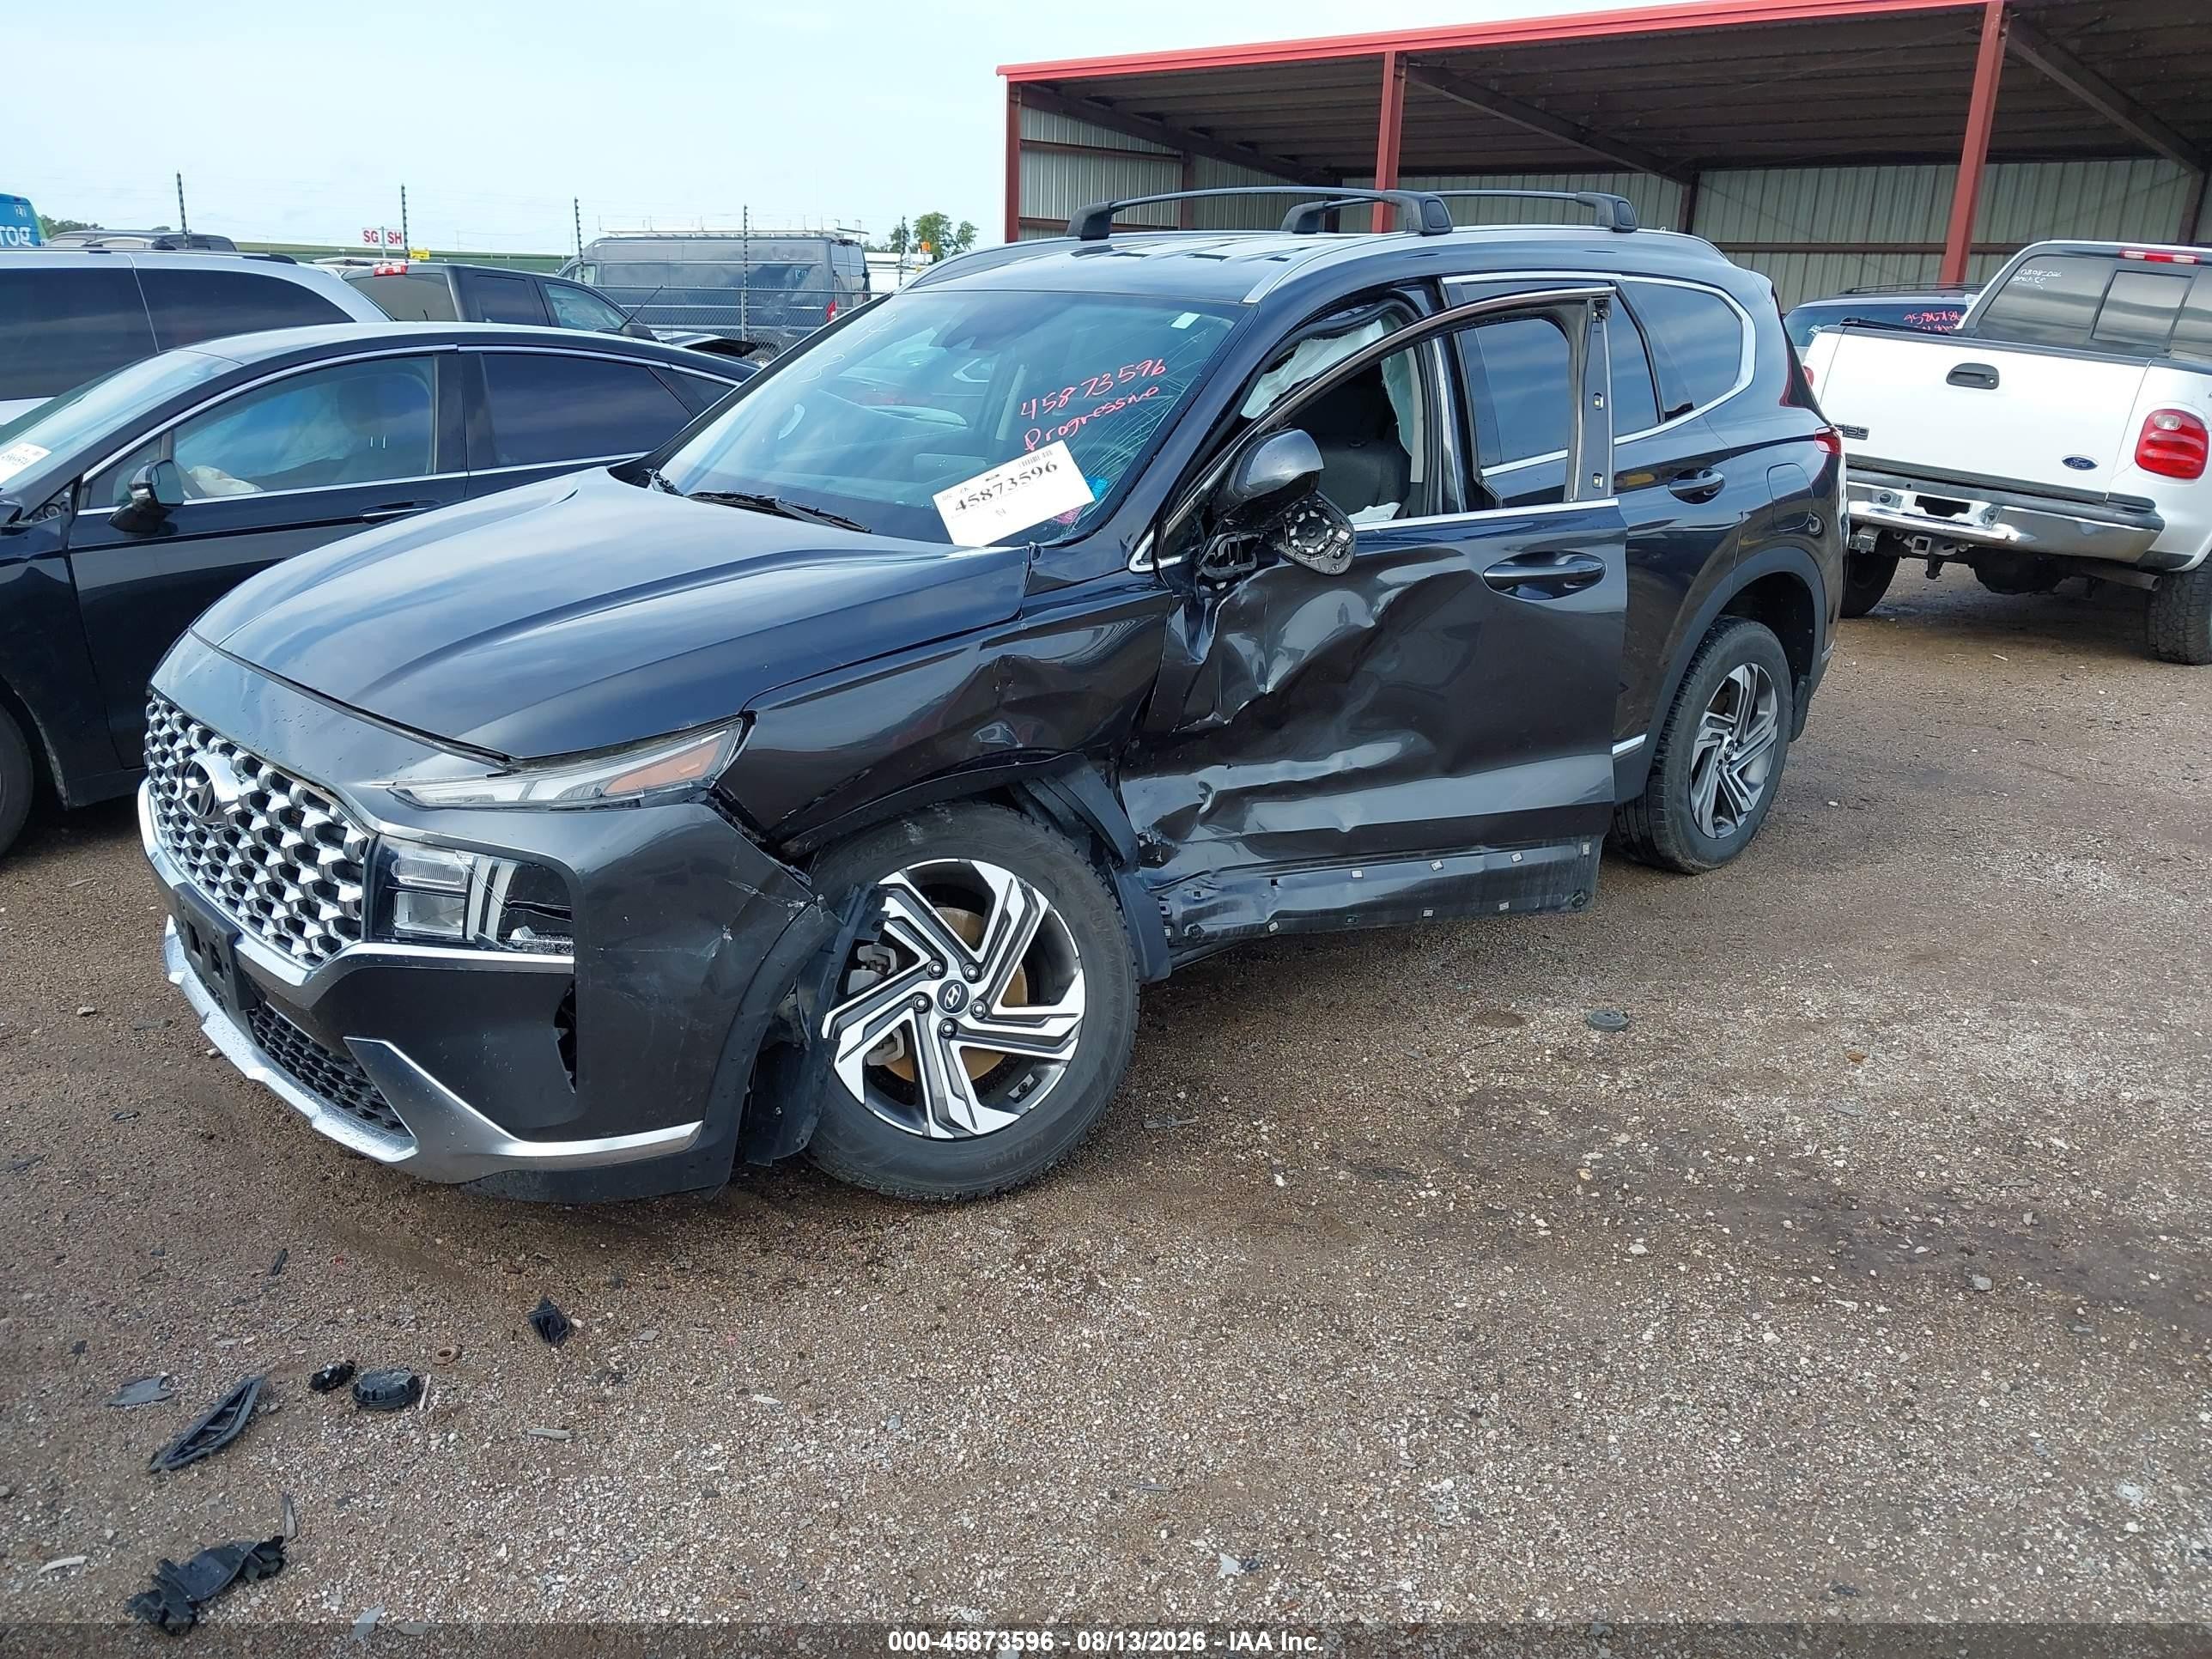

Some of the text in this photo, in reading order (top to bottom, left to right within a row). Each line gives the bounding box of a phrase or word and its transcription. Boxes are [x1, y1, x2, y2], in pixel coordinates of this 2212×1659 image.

[363, 229, 379, 243] SG
[387, 231, 402, 245] SH
[1020, 358, 1166, 420] 45873596
[955, 460, 1058, 513] 45873596
